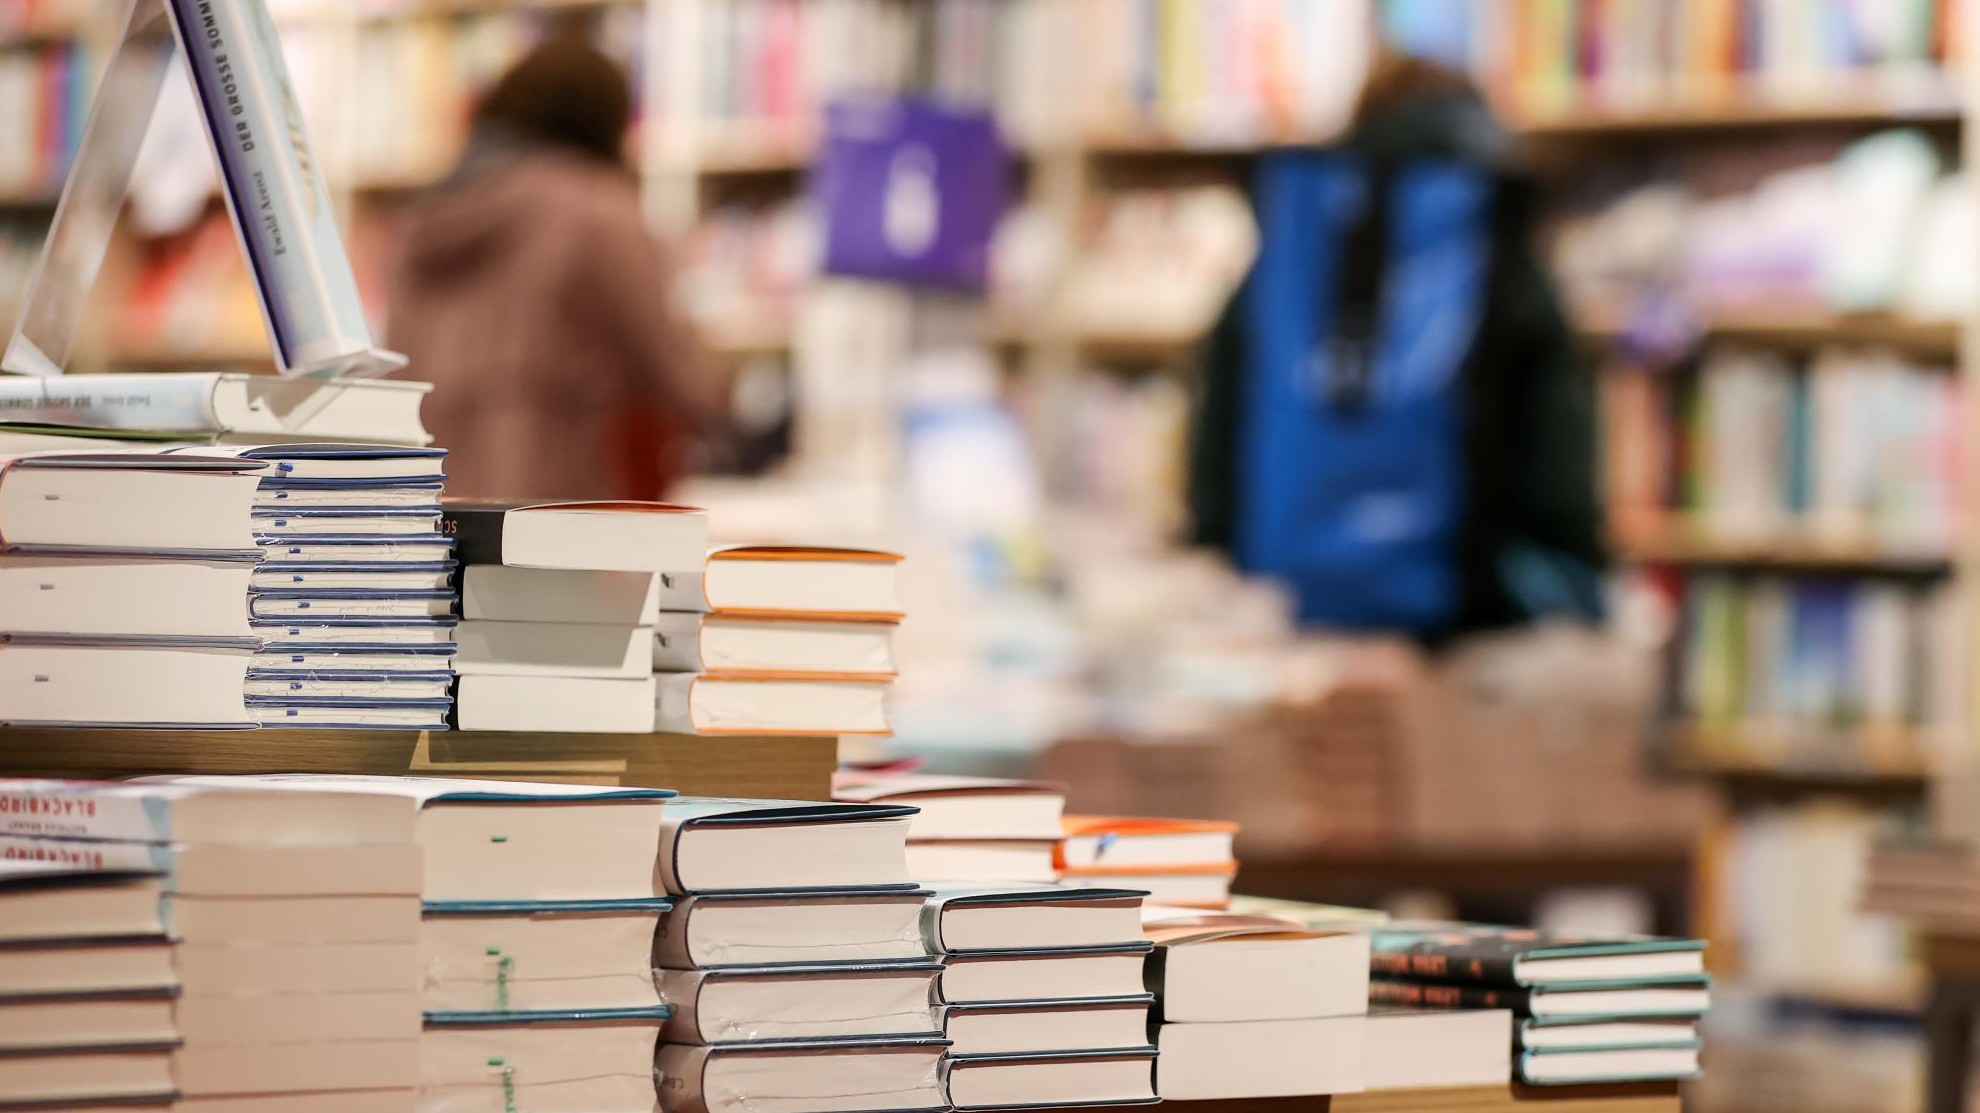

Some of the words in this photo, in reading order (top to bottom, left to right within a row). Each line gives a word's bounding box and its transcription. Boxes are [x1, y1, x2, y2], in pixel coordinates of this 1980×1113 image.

[197, 0, 224, 49] SOMM
[216, 54, 243, 116] GROSSE
[236, 121, 255, 152] DER
[0, 795, 96, 818] BLACKBIRD
